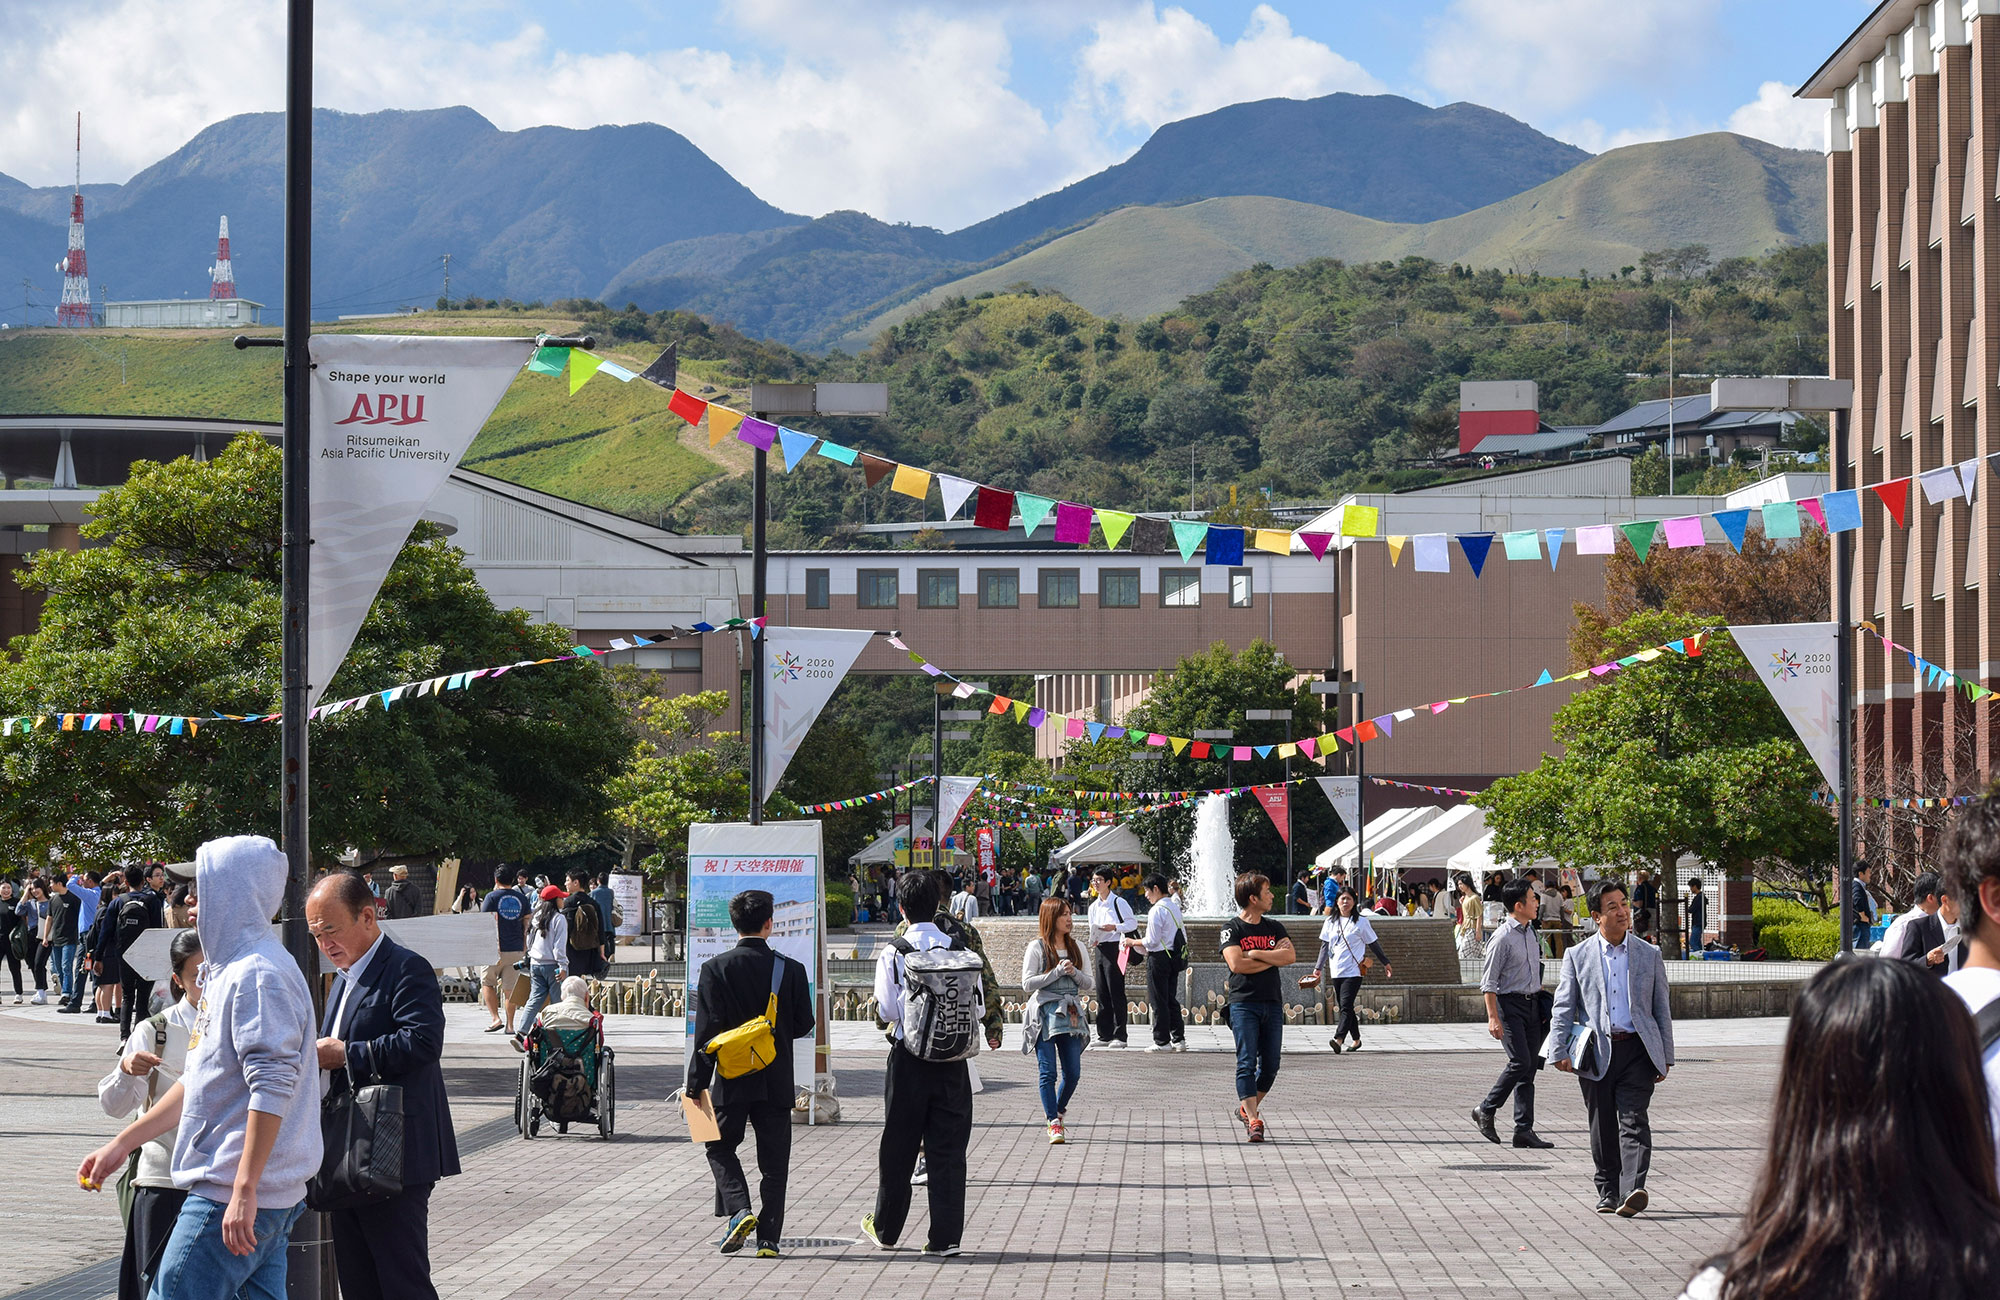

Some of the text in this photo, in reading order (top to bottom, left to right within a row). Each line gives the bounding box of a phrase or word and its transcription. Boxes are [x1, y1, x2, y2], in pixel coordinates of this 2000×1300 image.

[329, 371, 446, 385] Shape your world
[334, 393, 429, 426] APU
[346, 435, 420, 447] Ritsumeikan
[321, 447, 450, 463] Asia Pacific University
[806, 658, 835, 668] 2020
[1804, 653, 1832, 663] 2020
[806, 669, 834, 679] 2000
[1805, 664, 1832, 674] 2000
[945, 975, 959, 1033] NORTH
[935, 993, 947, 1031] FACE
[957, 1000, 971, 1032] THE
